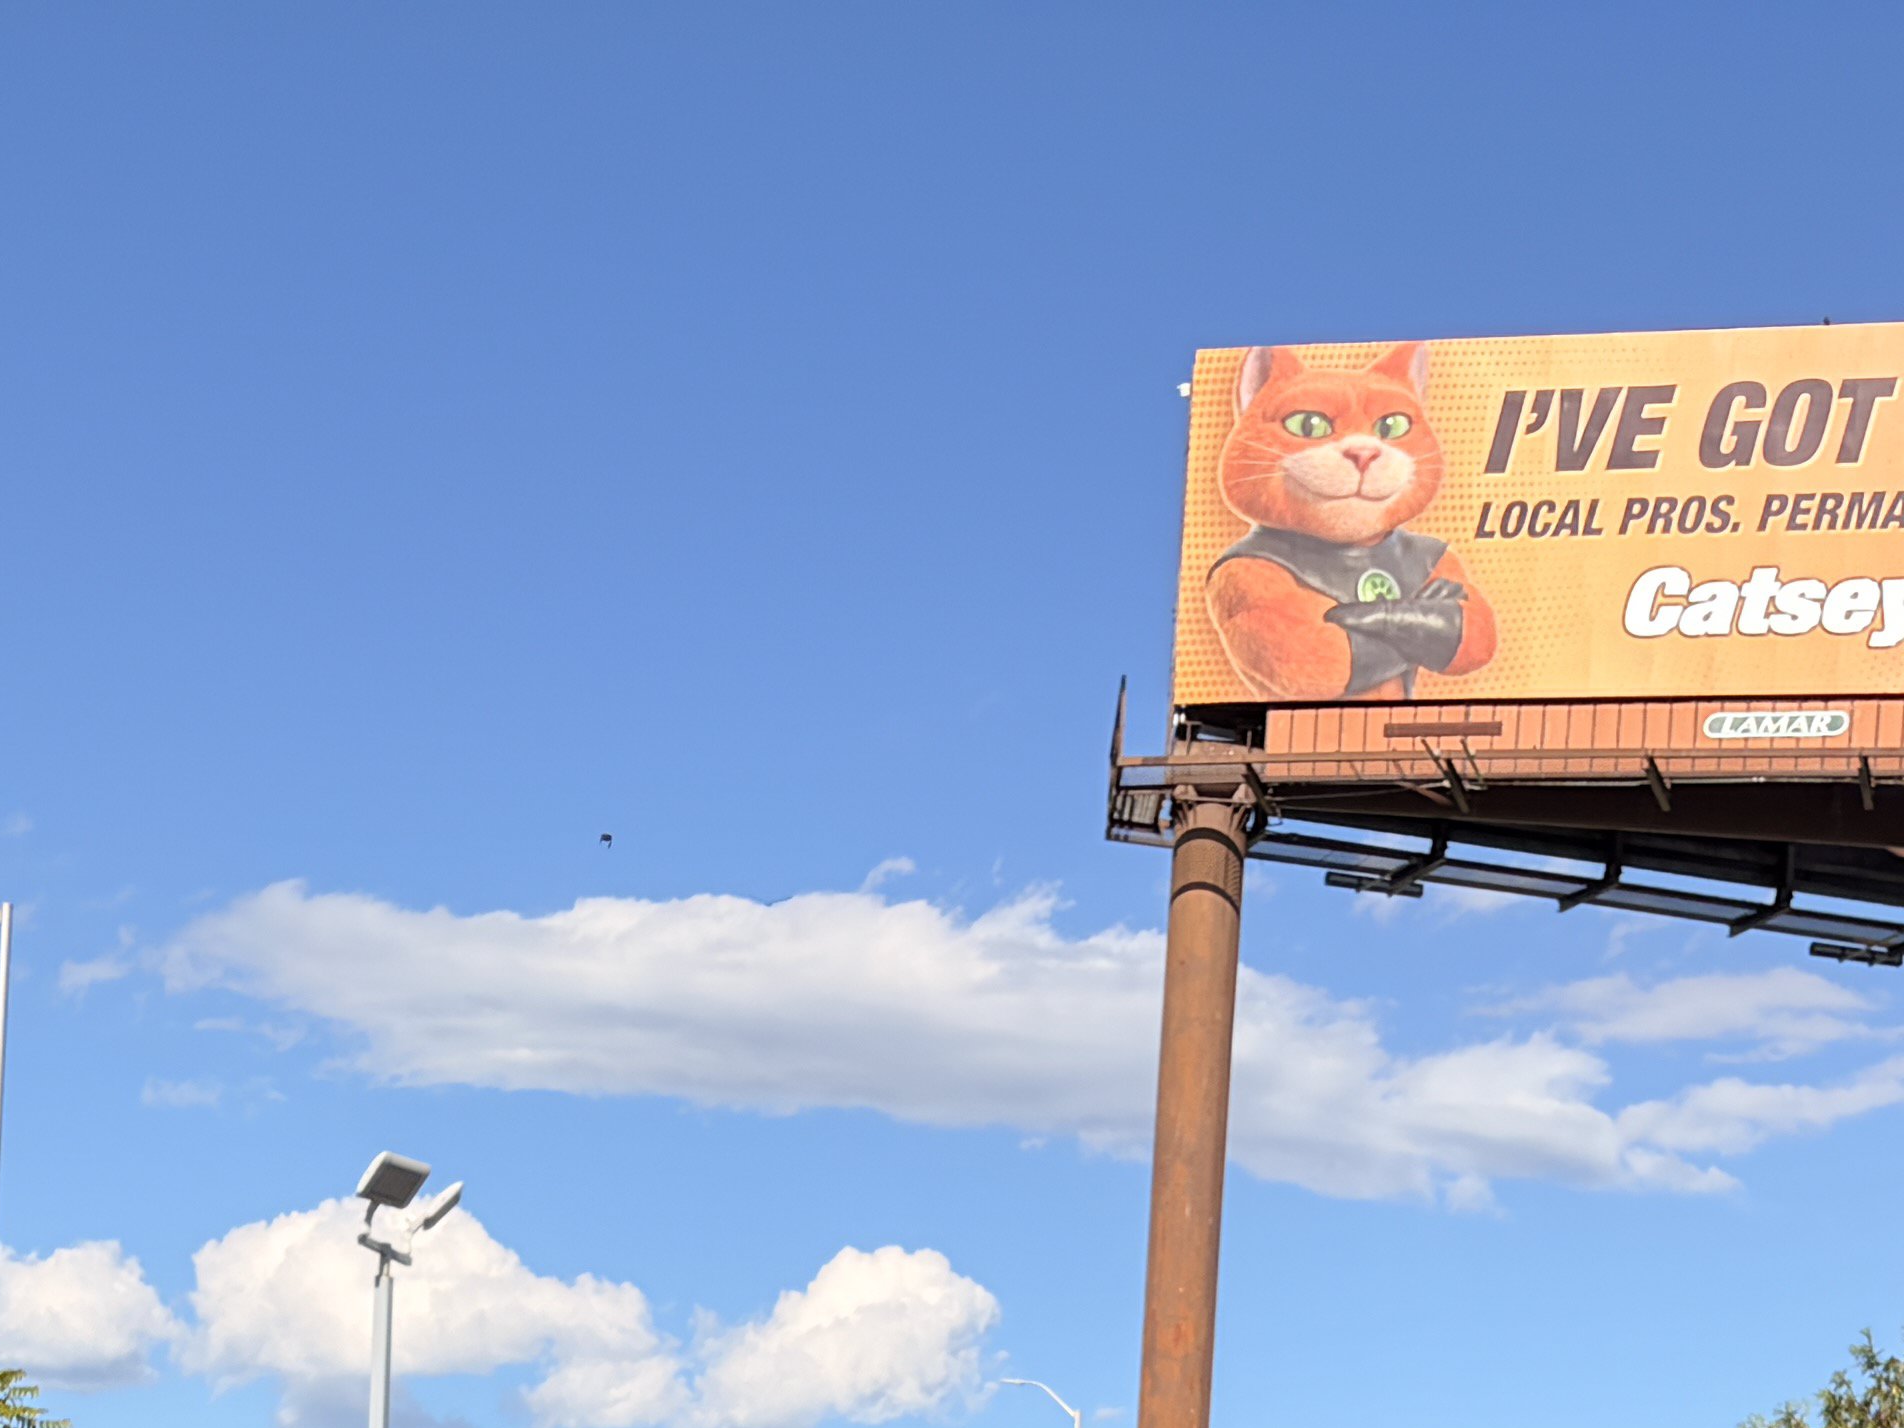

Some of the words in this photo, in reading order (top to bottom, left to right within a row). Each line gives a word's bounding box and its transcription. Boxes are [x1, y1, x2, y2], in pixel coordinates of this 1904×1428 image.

[1483, 384, 1678, 474] I'VE
[1698, 377, 1899, 469] GOT
[1474, 498, 1604, 539] LOCAL
[1618, 494, 1741, 536] PROS.
[1719, 713, 1833, 735] LAMAR
